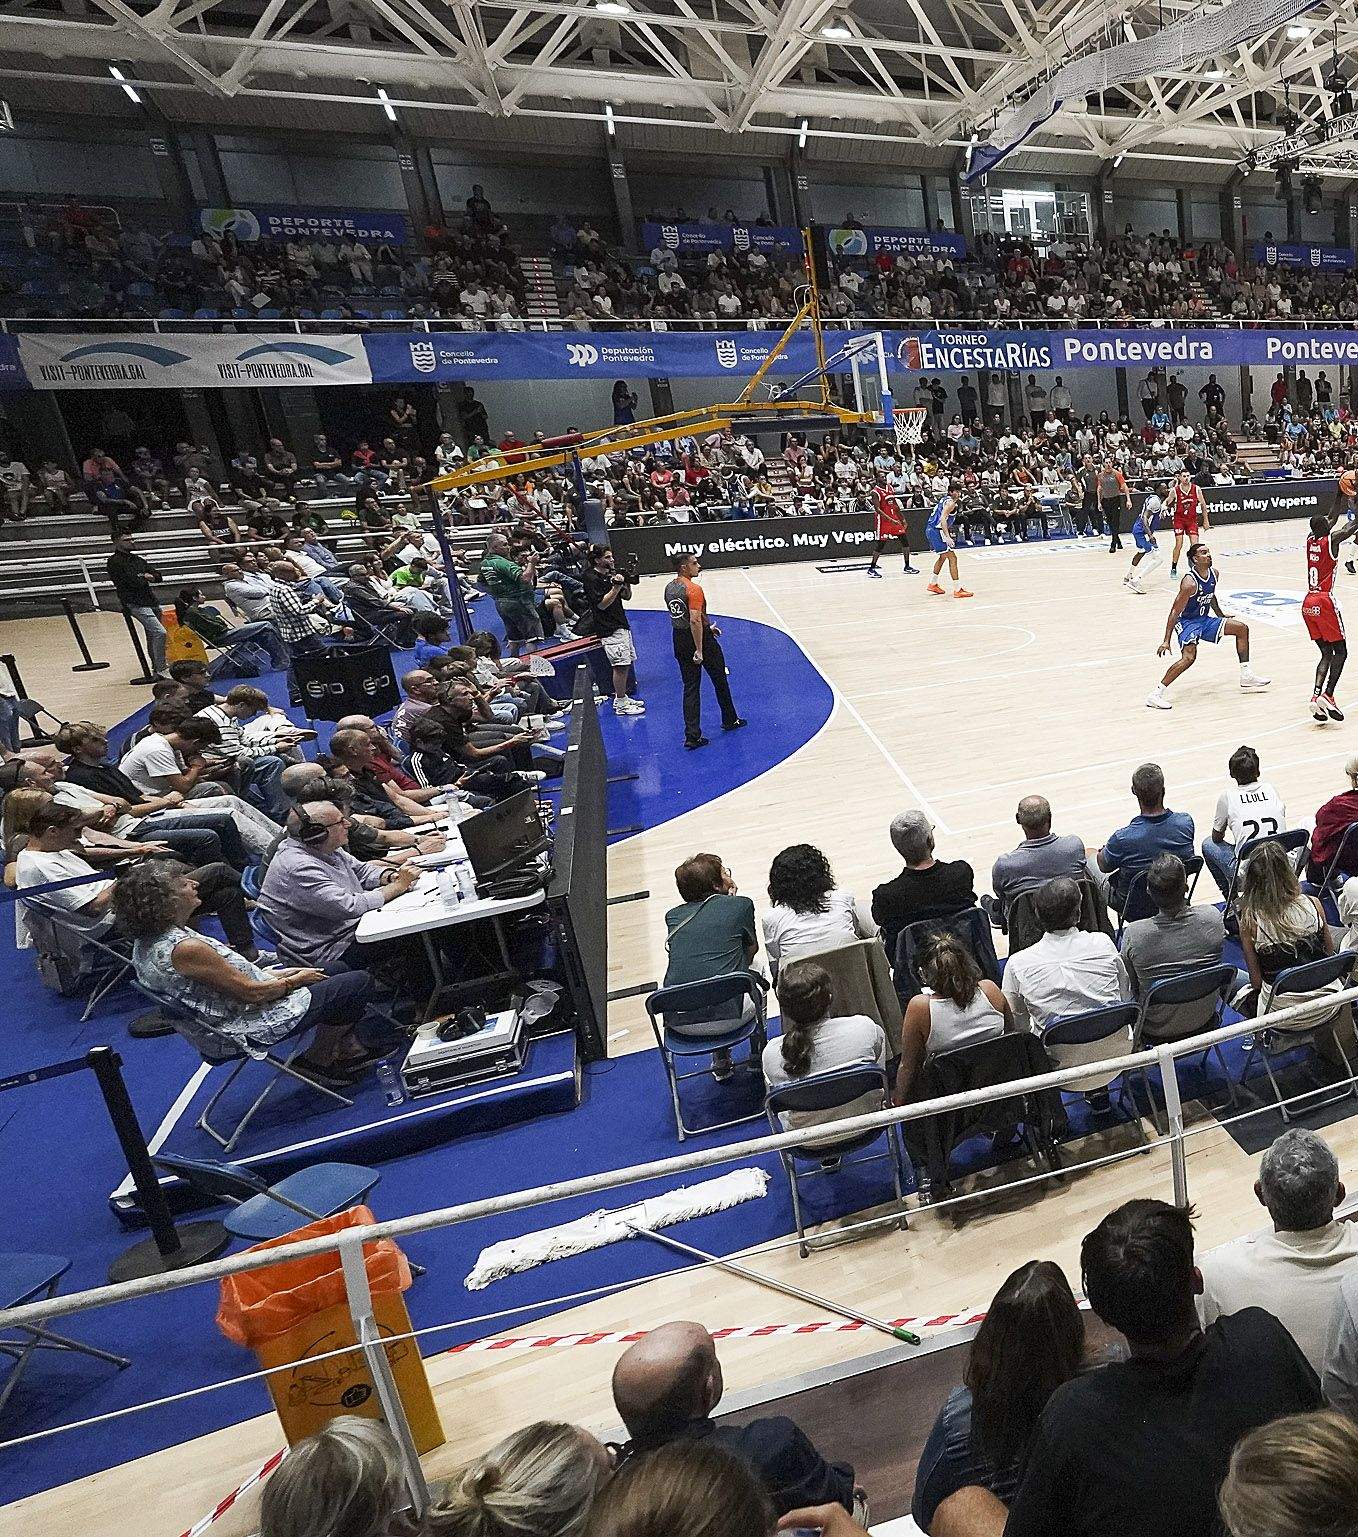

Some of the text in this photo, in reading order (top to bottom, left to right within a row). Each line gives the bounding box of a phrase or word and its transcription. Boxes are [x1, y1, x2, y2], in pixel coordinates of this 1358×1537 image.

[268, 216, 355, 228] DEPORTE
[873, 236, 931, 245] DEPORTE
[938, 334, 988, 345] TORNEO
[601, 346, 654, 355] Deputación
[1063, 335, 1214, 361] Pontevedra
[603, 354, 655, 362] Pontevedra
[1243, 499, 1268, 512] Muy
[1270, 495, 1317, 508] Vepersa
[664, 542, 704, 557] Muy
[708, 534, 789, 554] eléctrico.
[793, 532, 829, 549] Muy
[1309, 566, 1319, 587] 0
[670, 602, 683, 614] 82
[1200, 605, 1206, 617] 0
[1240, 791, 1269, 803] LLULL
[1242, 816, 1279, 841] 23
